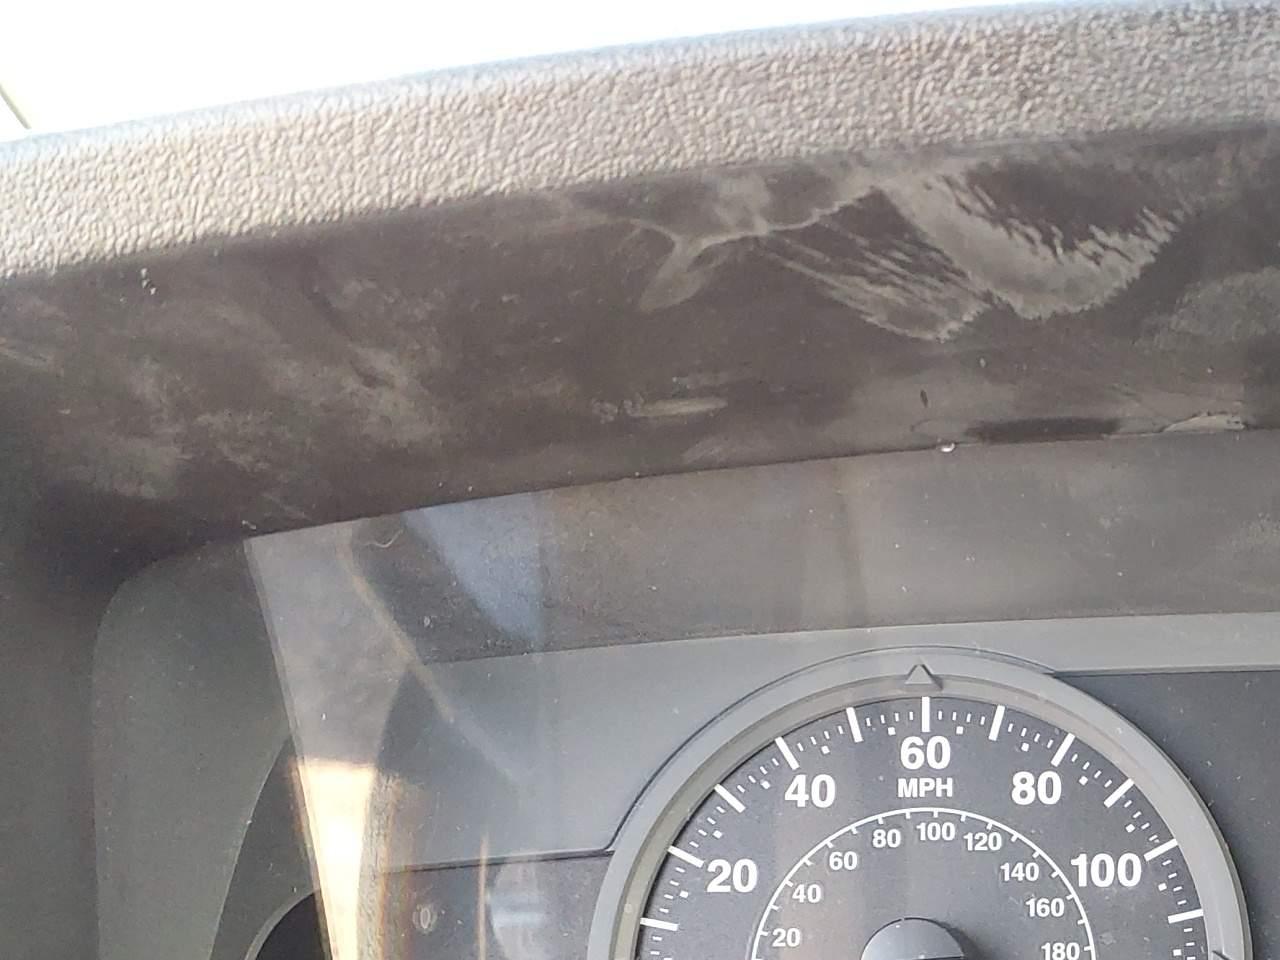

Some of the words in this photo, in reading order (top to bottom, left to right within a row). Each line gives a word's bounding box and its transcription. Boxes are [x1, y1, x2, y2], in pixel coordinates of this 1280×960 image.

[900, 736, 951, 769] 60
[784, 775, 836, 808] 40
[898, 778, 954, 799] MPH
[1011, 771, 1062, 805] 80
[872, 829, 901, 849] 80
[916, 823, 956, 842] 100
[963, 831, 1003, 851] 120
[828, 851, 858, 871] 60
[1071, 853, 1142, 887] 100
[707, 859, 758, 893] 20
[1000, 862, 1040, 882] 140
[793, 884, 822, 904] 40
[1026, 898, 1065, 918] 160
[772, 927, 801, 948] 20
